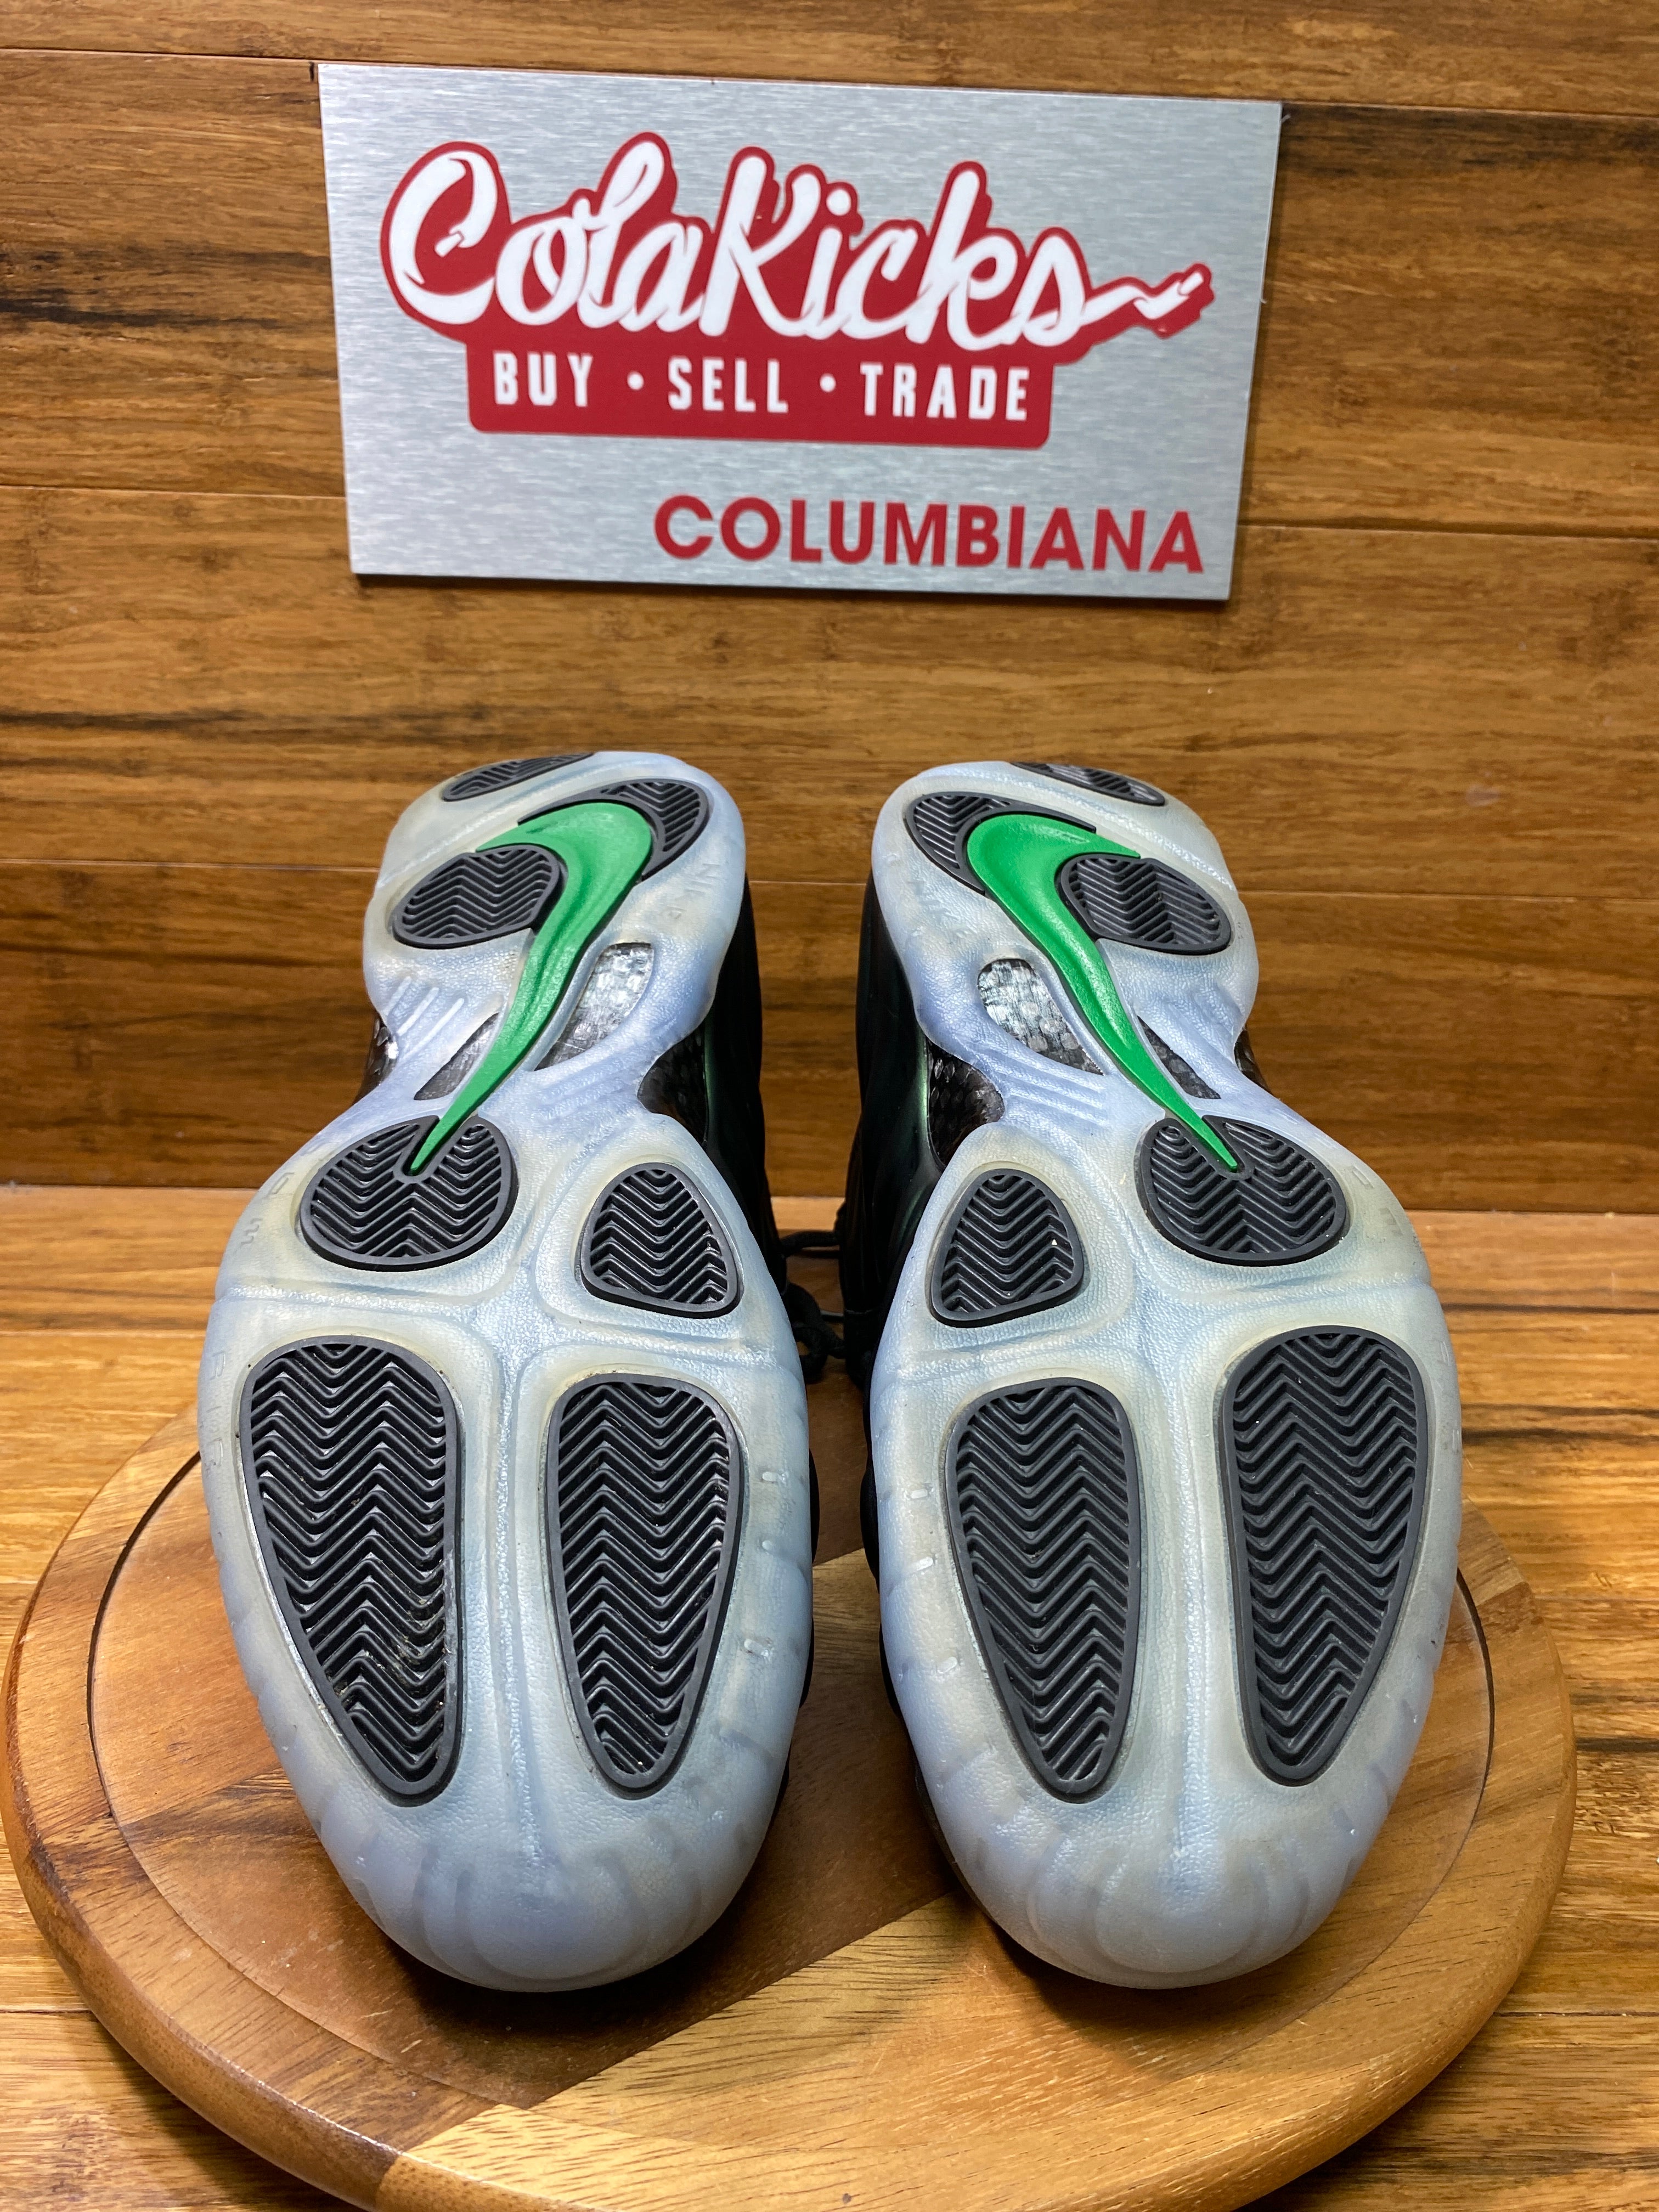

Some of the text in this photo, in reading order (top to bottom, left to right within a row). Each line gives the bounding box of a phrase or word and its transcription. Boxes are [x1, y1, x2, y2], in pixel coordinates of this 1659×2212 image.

[388, 140, 1205, 352] ColaKicks
[494, 352, 1029, 420] BUY SELL TRADE
[654, 494, 1203, 573] COLUMBIANA
